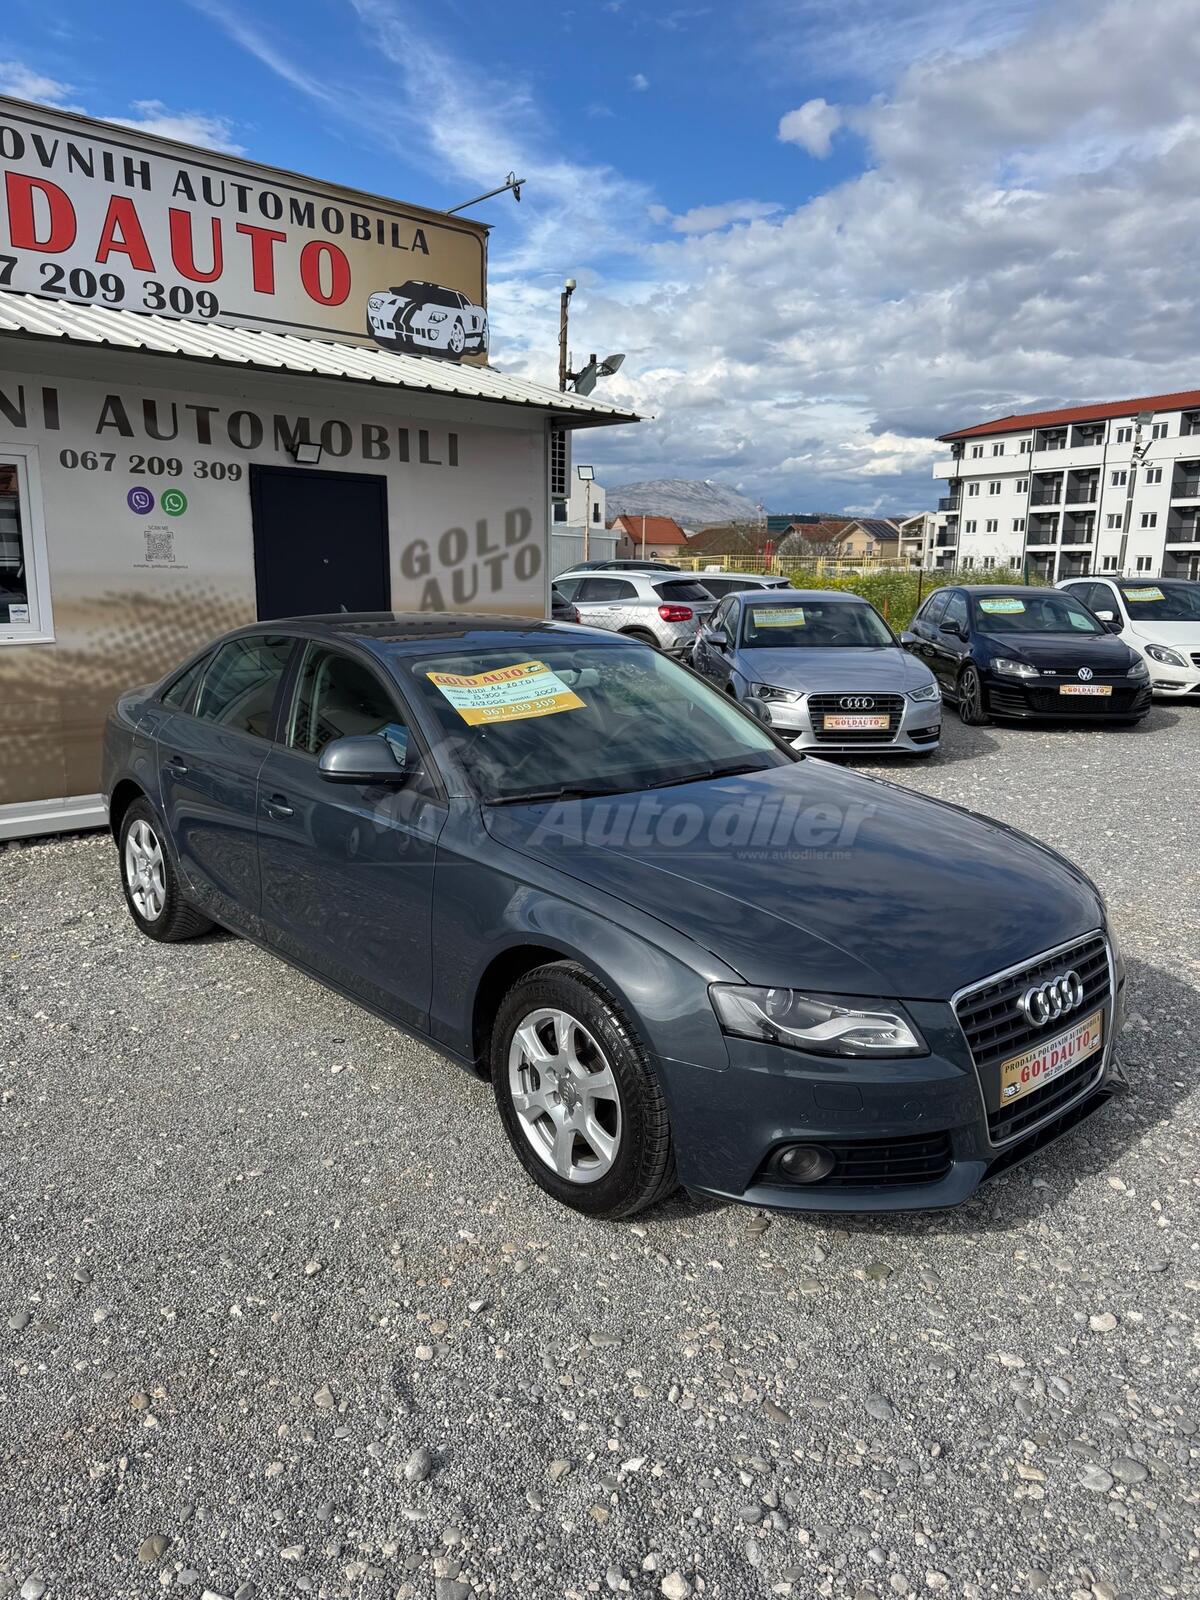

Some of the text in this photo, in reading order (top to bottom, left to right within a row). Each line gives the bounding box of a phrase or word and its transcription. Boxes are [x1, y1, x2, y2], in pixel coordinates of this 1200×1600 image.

[0, 126, 430, 256] OVNIH AUTOMOBILA
[5, 170, 351, 306] DAUTO
[0, 254, 219, 318] 7 209 309
[96, 394, 459, 467] AUTOMOBILI
[59, 449, 242, 481] 067 209 309
[400, 506, 533, 580] GOLD
[419, 543, 541, 611] AUTO
[435, 668, 523, 686] GOLD AUTO
[482, 707, 505, 716] 067
[511, 703, 532, 713] 209
[534, 698, 557, 708] 309
[1020, 1030, 1090, 1083] GOLDAUTO
